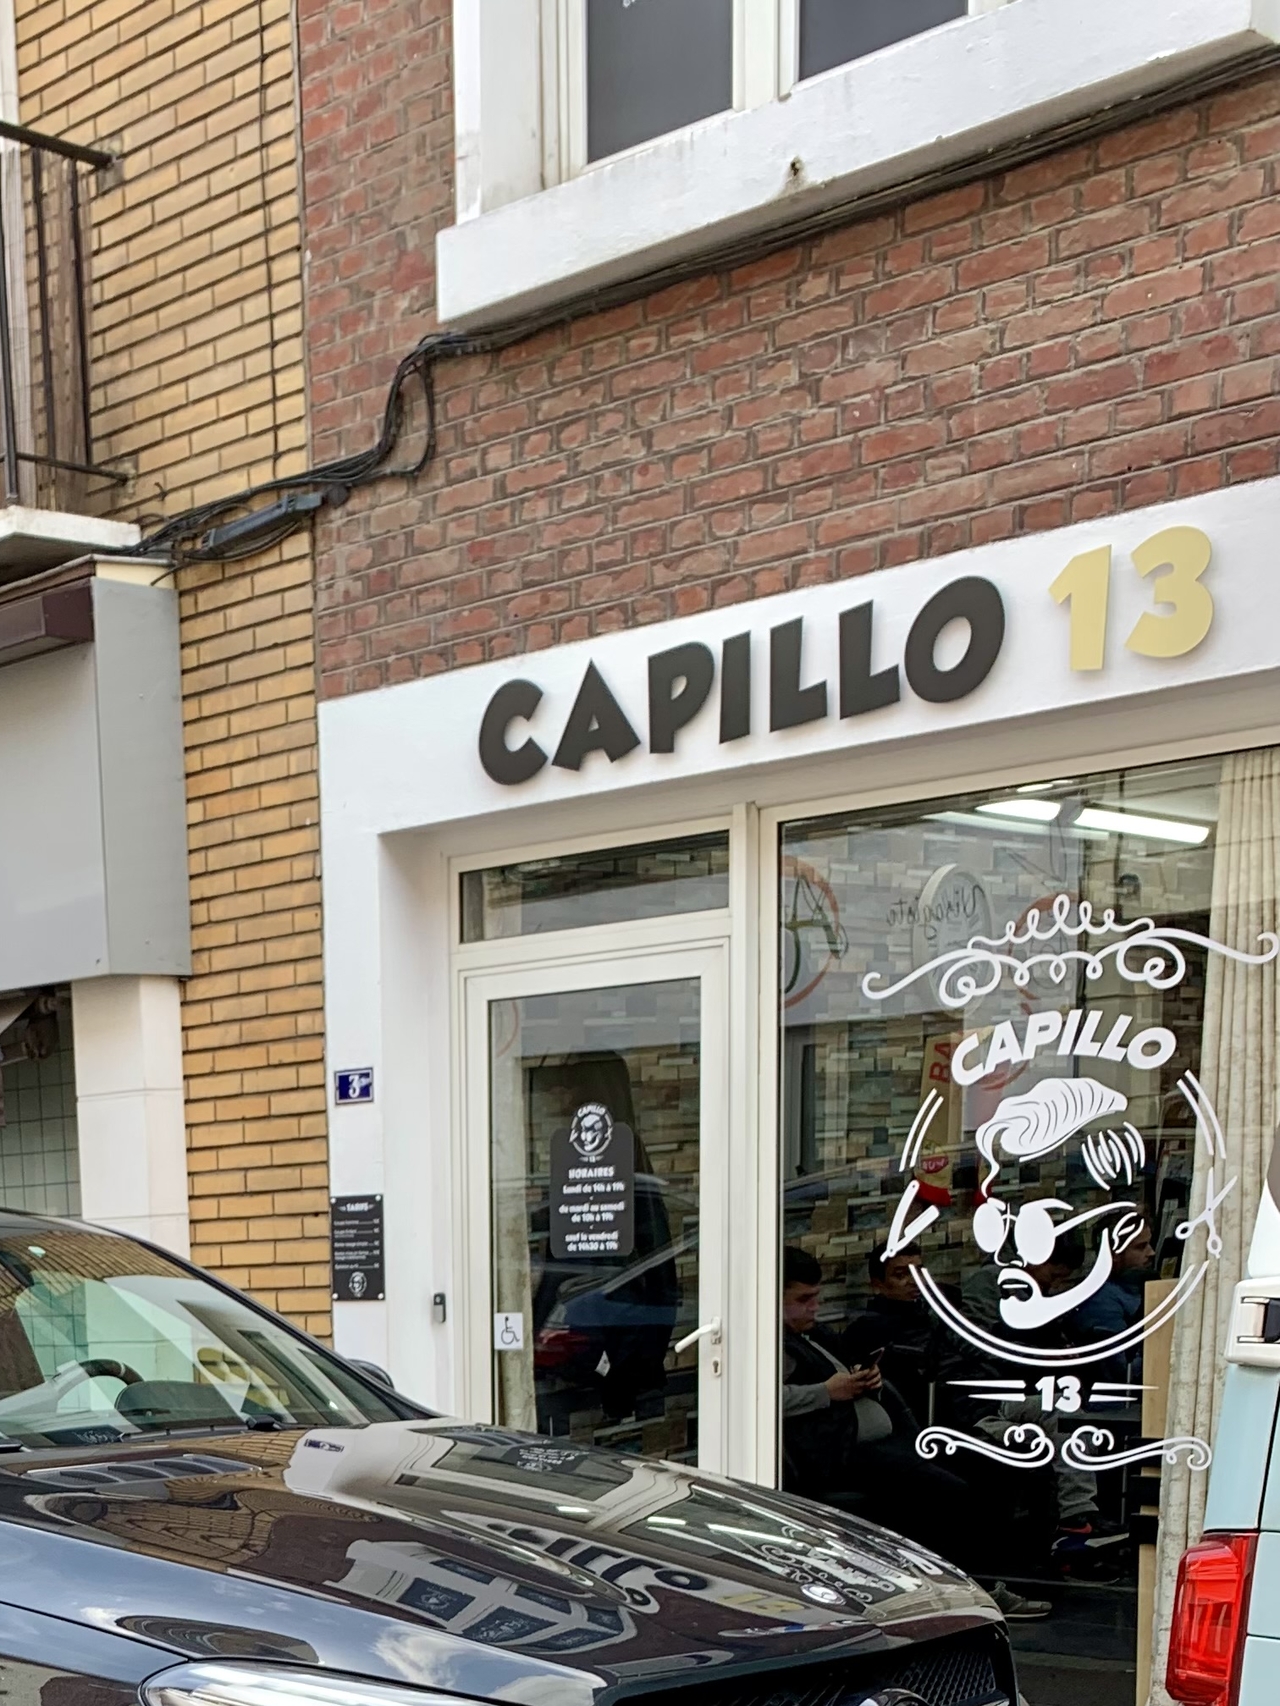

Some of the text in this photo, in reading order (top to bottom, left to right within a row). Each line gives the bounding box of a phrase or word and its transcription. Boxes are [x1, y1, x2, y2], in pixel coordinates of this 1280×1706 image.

[477, 525, 1215, 786] CAPILLO 13
[950, 1008, 1177, 1087] CAPILLO
[569, 1166, 615, 1179] HORAIRES
[1034, 1374, 1082, 1414] 13
